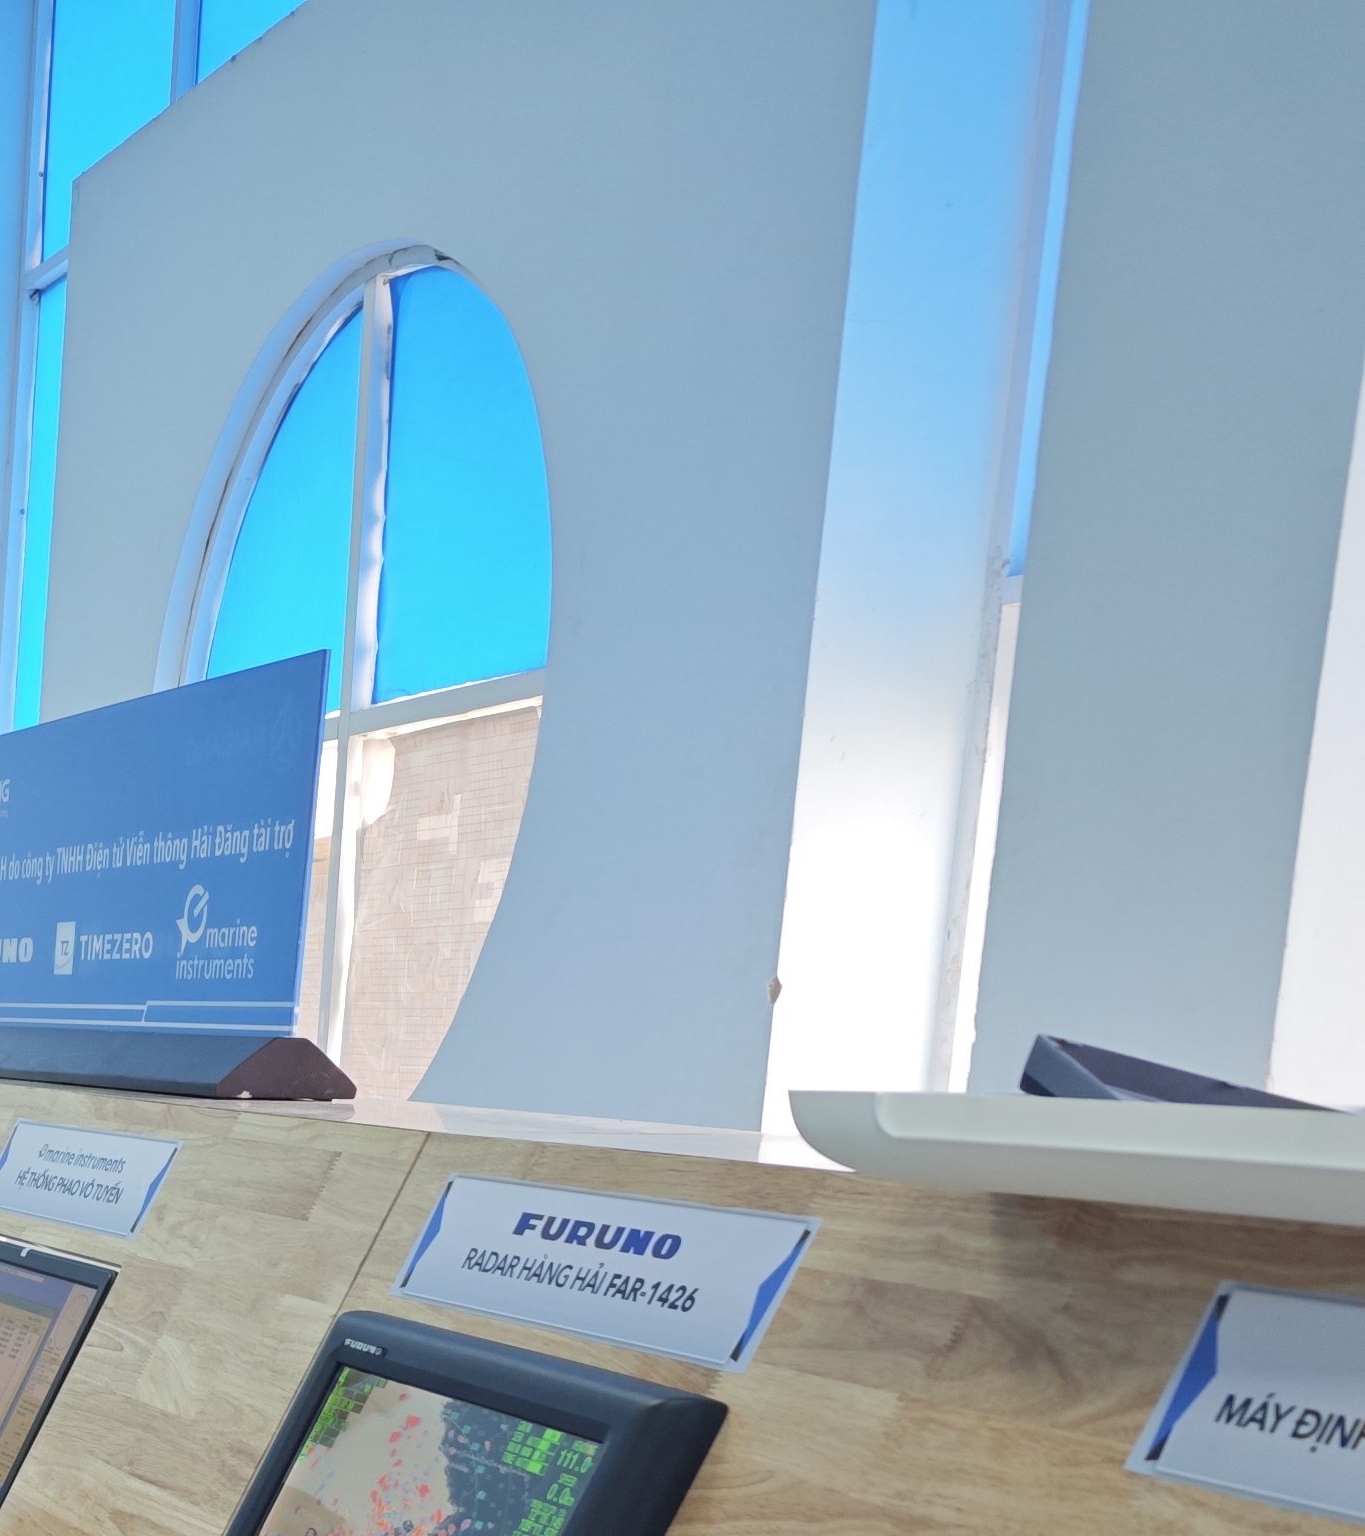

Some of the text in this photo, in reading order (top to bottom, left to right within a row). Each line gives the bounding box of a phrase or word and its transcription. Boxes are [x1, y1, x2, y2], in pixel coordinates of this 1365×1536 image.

[9, 853, 20, 881] do
[21, 852, 44, 885] công
[45, 851, 55, 885] ty
[56, 844, 85, 875] TNHH
[85, 841, 110, 879] Điện
[112, 837, 125, 869] tử
[126, 830, 151, 867] Viễn
[153, 831, 188, 870] thông
[190, 824, 213, 860] Hải
[214, 824, 250, 864] Đăng
[252, 817, 272, 853] tài
[274, 818, 295, 859] trợ
[79, 931, 153, 961] TIMEZERO
[205, 917, 258, 949] marine
[175, 951, 255, 980] instruments
[43, 1147, 126, 1174] marine instruments
[15, 1167, 124, 1204] HỆ THỐNG PHAO VÔ TUYẾN
[512, 1211, 682, 1260] FURUNO
[461, 1248, 699, 1313] RADAR HÀNG HẢI FAR-1426
[344, 1338, 382, 1356] FURUNO
[1214, 1392, 1296, 1433] MÁY
[556, 1449, 593, 1473] 111.0
